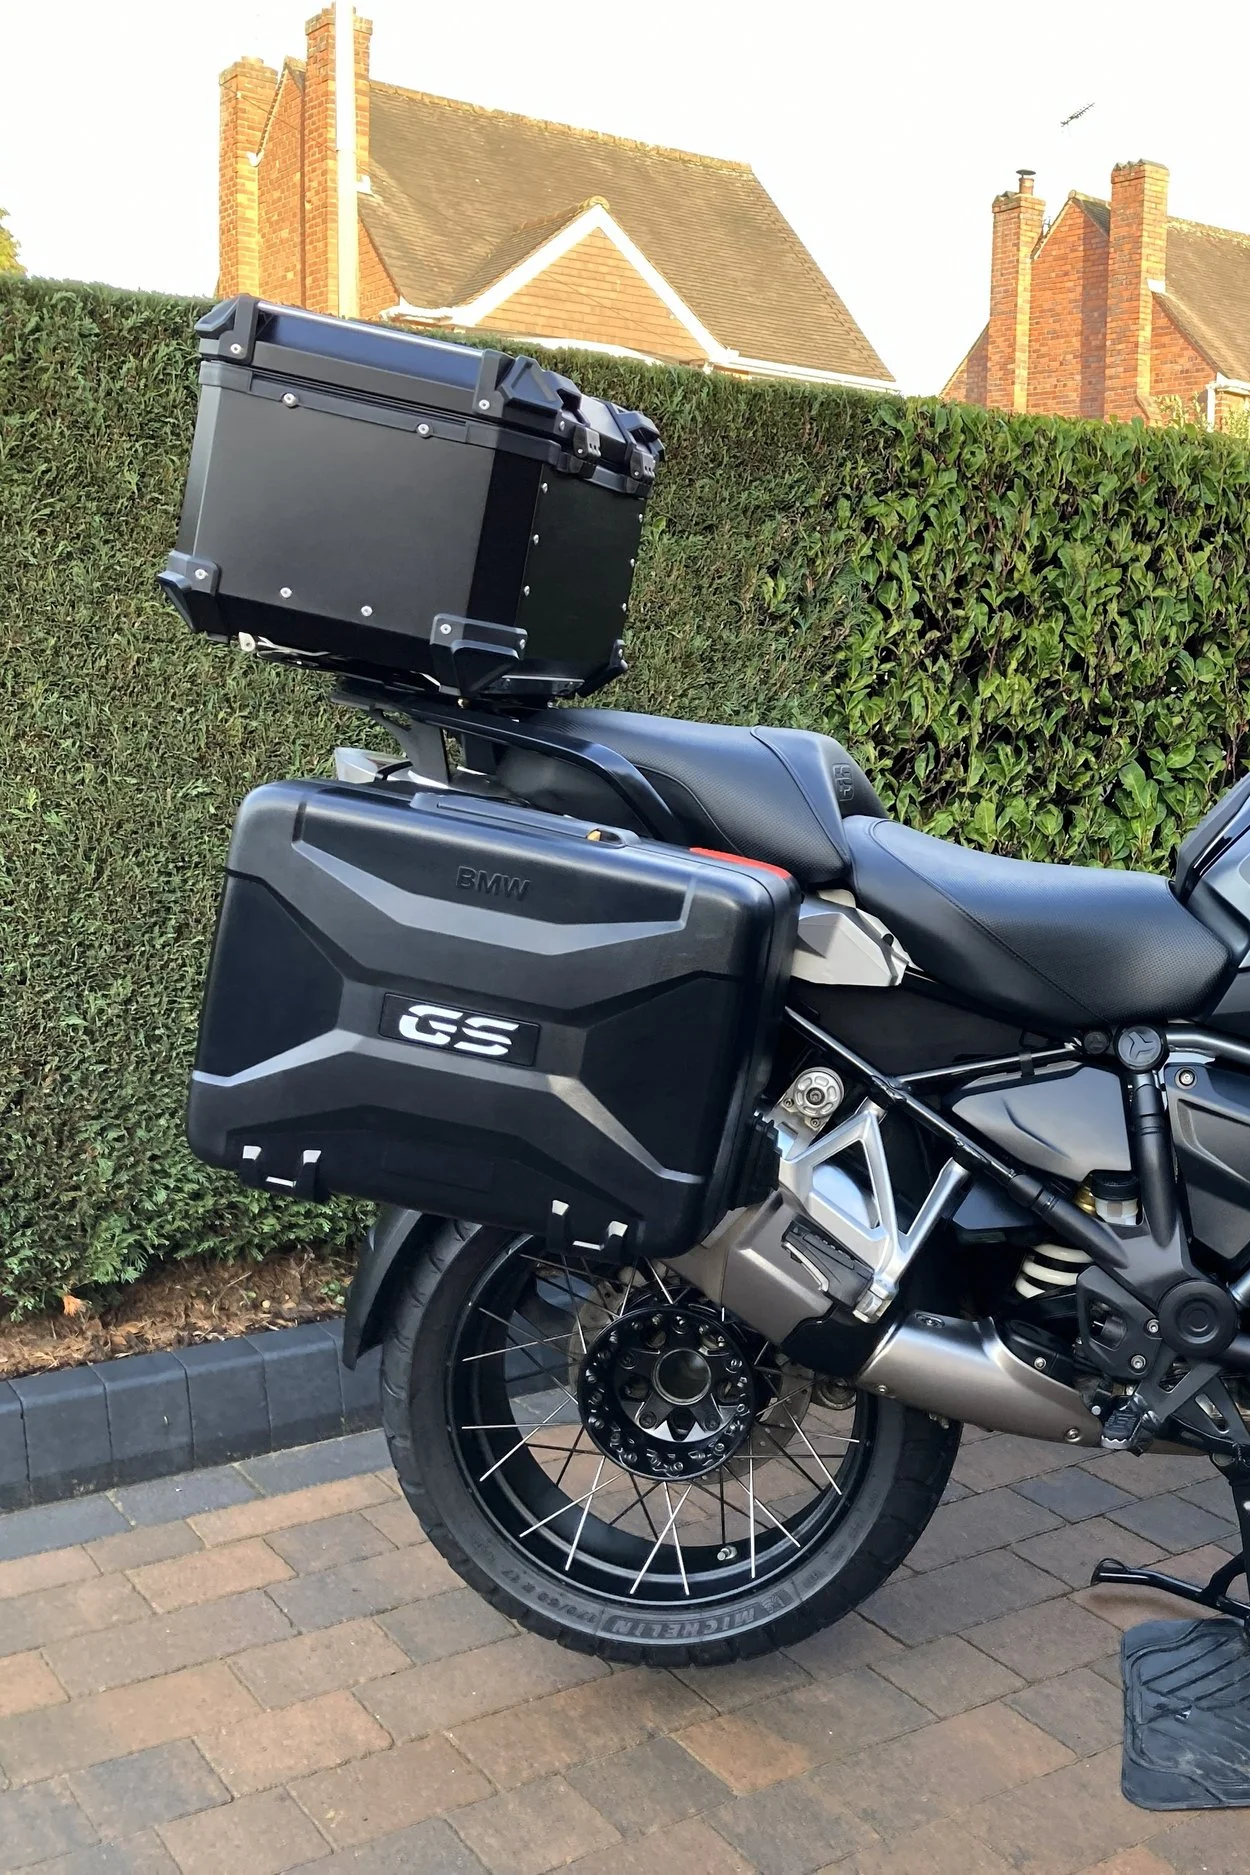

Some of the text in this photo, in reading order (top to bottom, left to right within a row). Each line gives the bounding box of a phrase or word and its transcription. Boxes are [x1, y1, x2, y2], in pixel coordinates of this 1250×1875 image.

[456, 865, 532, 901] BMW
[399, 1004, 520, 1056] GS
[612, 1607, 755, 1638] MICHELIN
